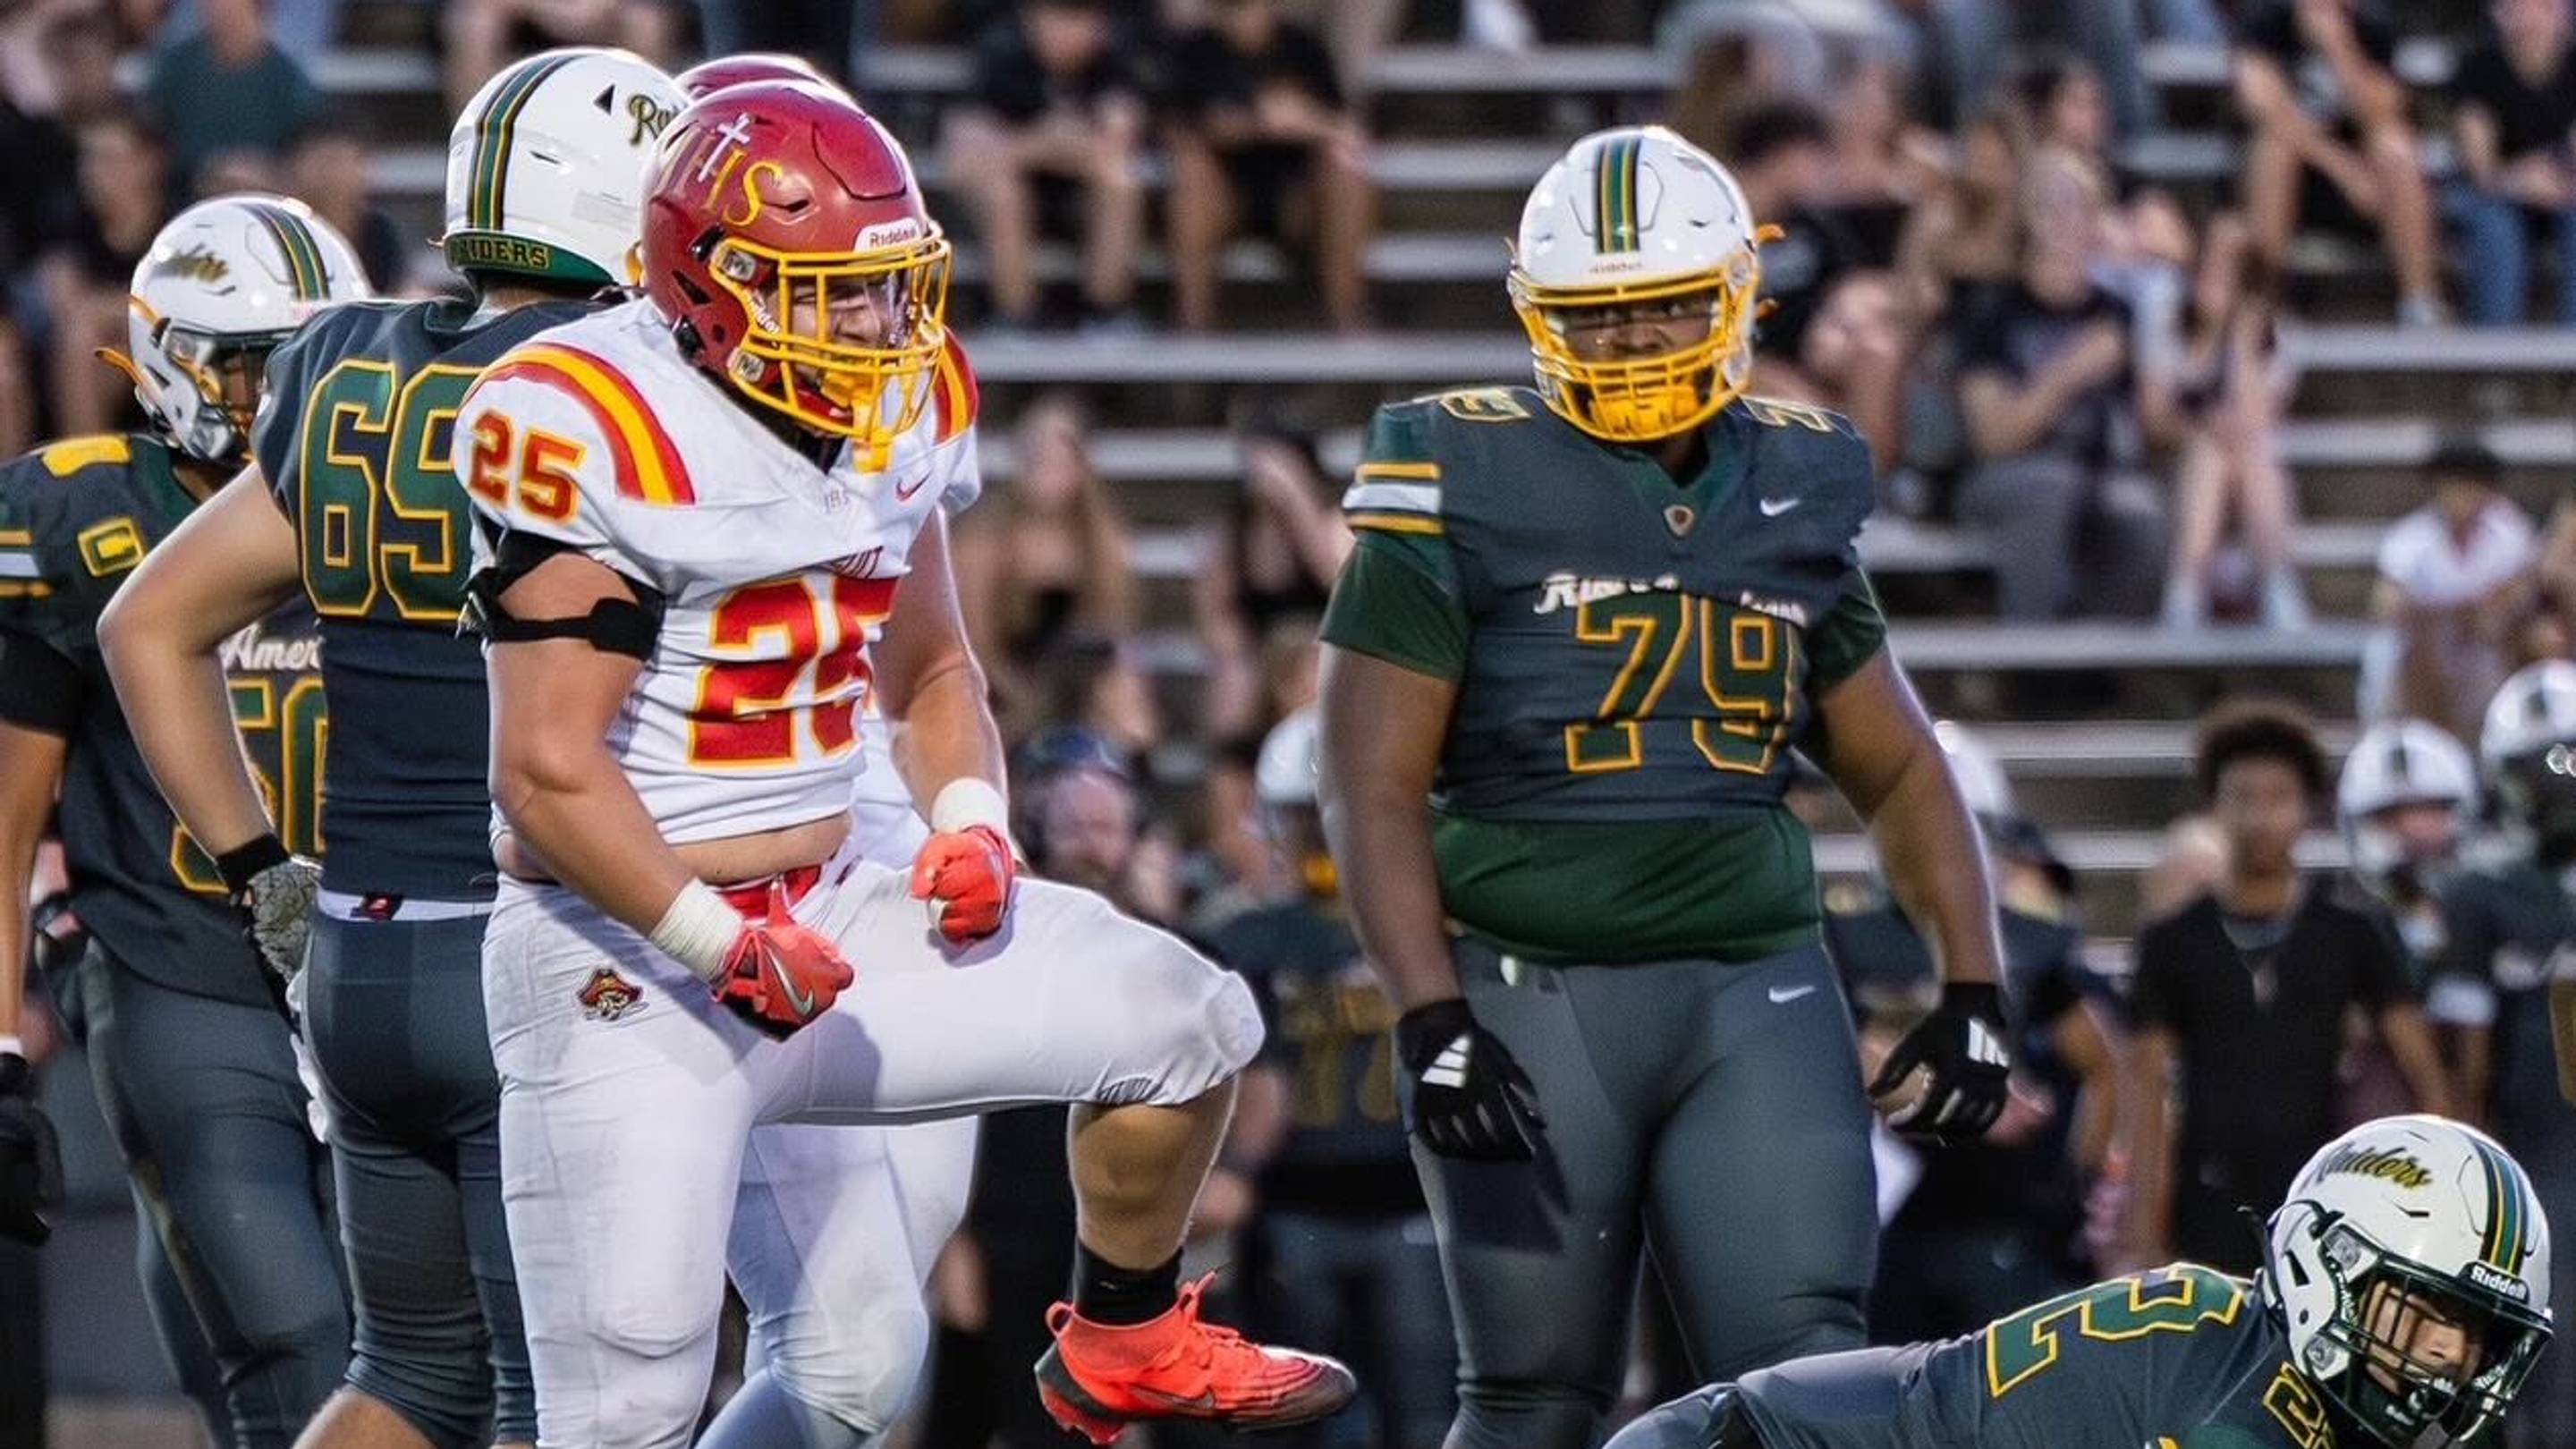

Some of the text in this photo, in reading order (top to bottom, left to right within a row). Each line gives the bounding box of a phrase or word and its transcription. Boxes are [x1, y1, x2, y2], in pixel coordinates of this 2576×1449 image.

[300, 359, 488, 619] 69
[466, 409, 586, 525] 25
[687, 572, 900, 772] 25
[1564, 588, 1792, 775] 79
